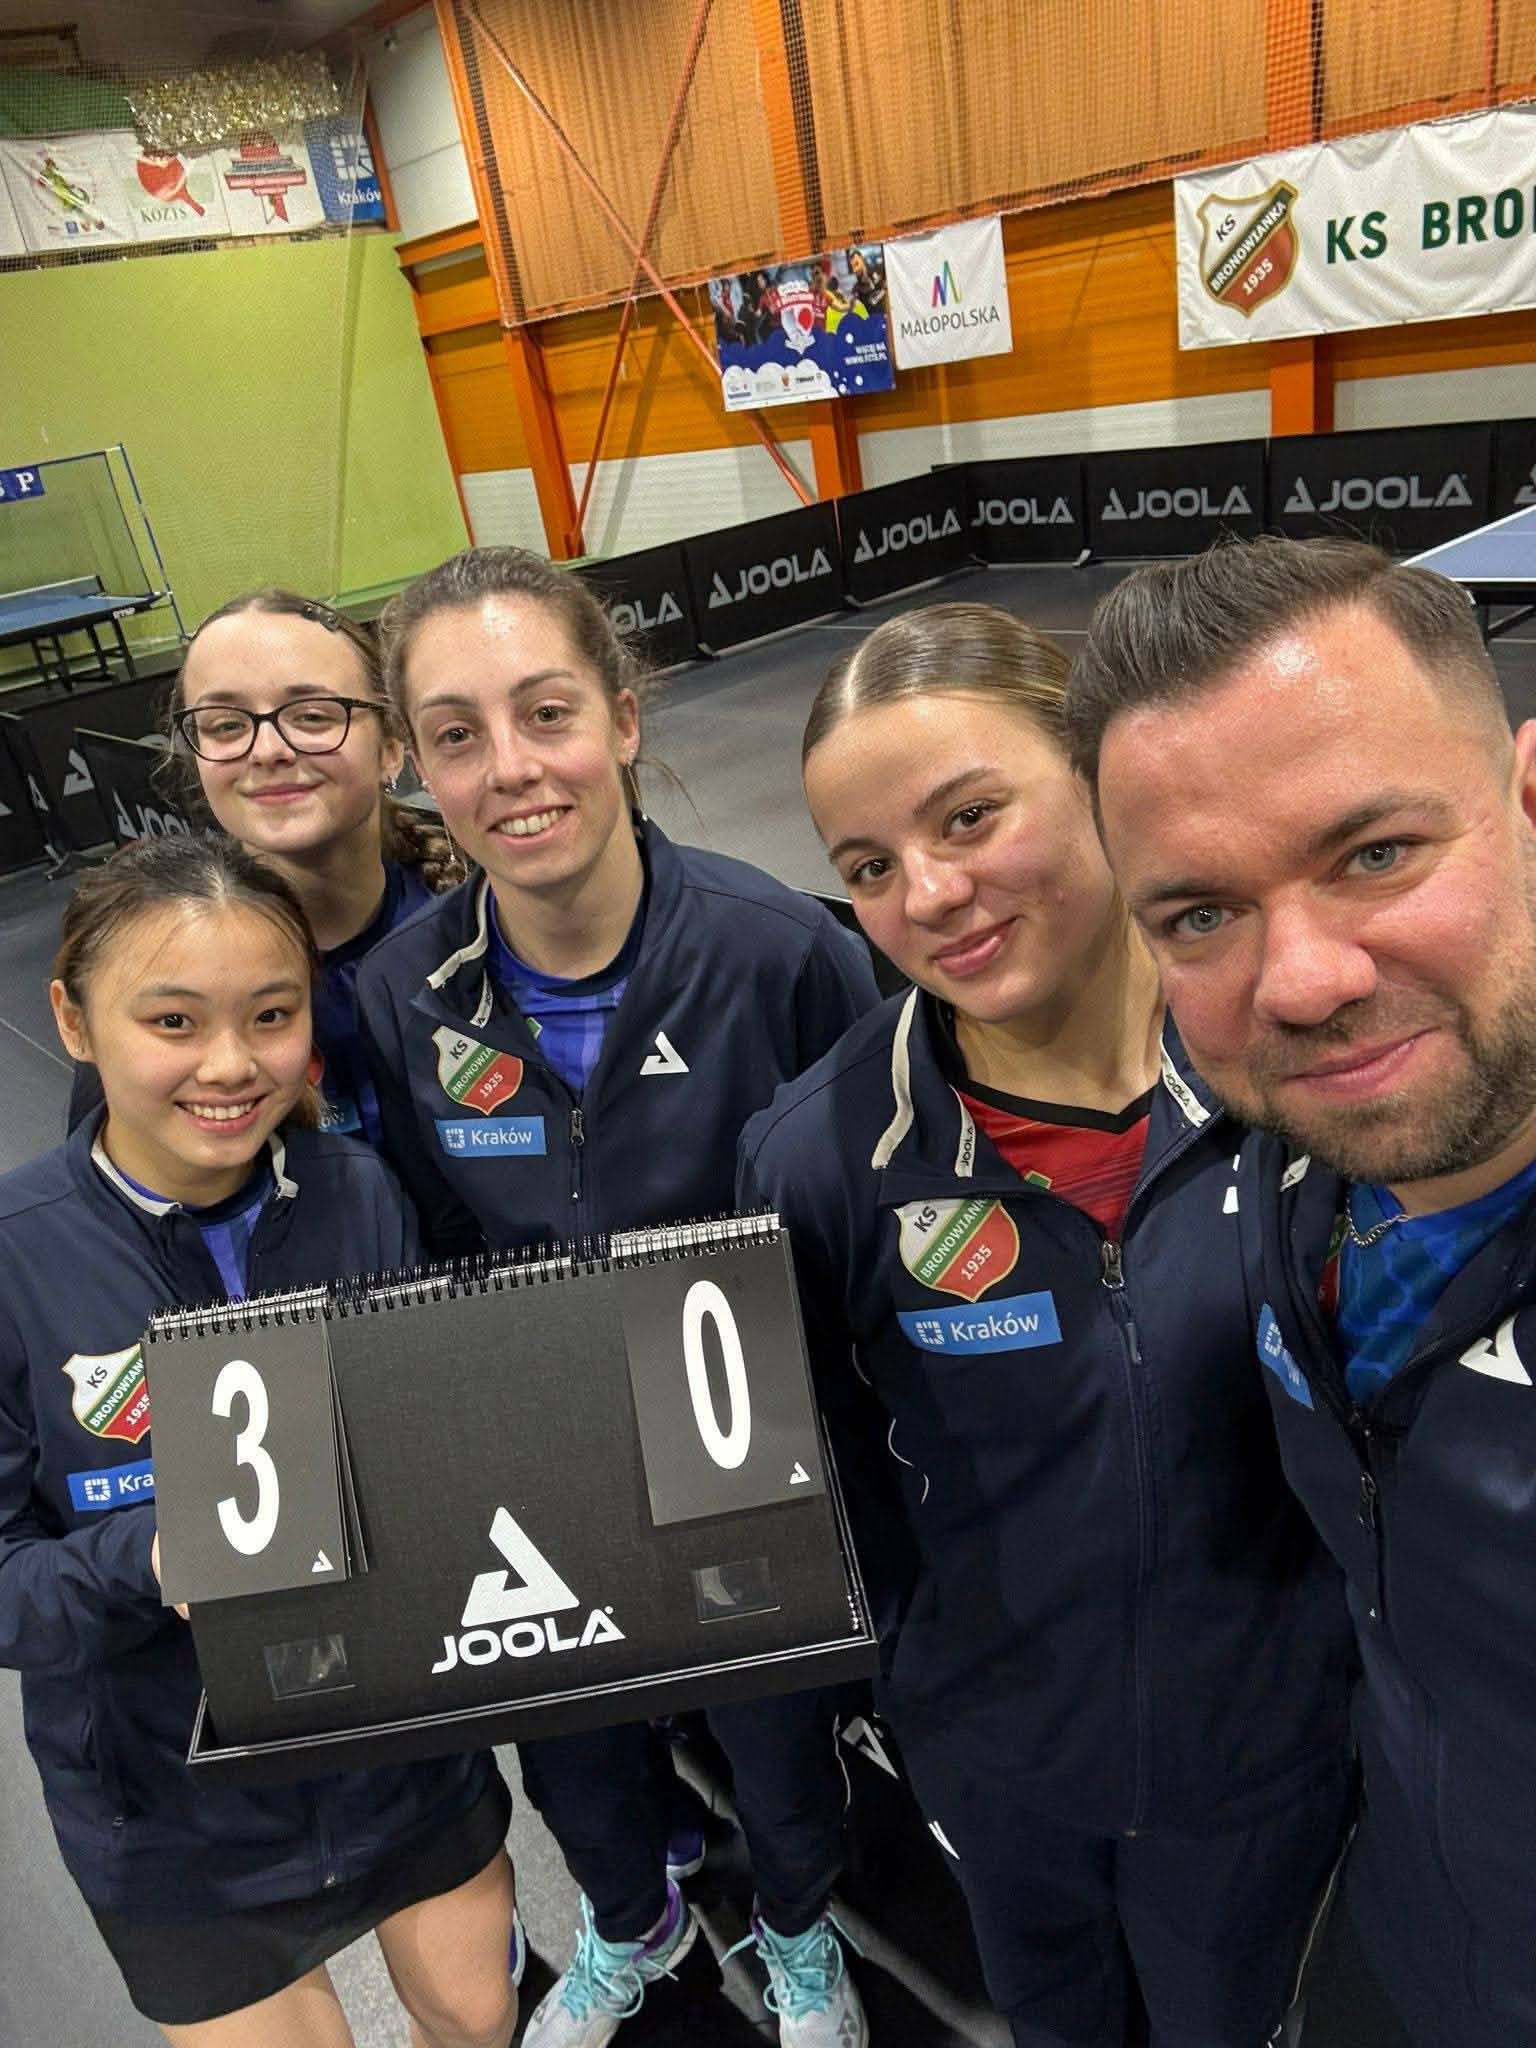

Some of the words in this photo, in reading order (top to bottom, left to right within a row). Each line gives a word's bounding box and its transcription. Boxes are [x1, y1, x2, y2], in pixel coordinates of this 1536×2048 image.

[1216, 214, 1236, 242] KS
[1327, 211, 1388, 263] KS
[1422, 187, 1536, 250] BRO
[1210, 201, 1287, 292] BRONOWIANKA
[1243, 258, 1273, 296] 1935
[901, 305, 1000, 338] MAŁOPOLSKA
[1128, 485, 1252, 520] JOOLA
[1319, 473, 1473, 512] JOOLA
[970, 497, 1075, 527] JOOLA
[876, 508, 962, 556] JOOLA
[734, 548, 832, 600] JOOLA
[450, 1039, 468, 1060] KS
[480, 1071, 504, 1098] 1935
[1165, 1072, 1190, 1106] JOOLA
[471, 1127, 532, 1146] Kraków
[960, 1126, 974, 1167] JOOLA
[914, 1206, 937, 1232] KS
[961, 1244, 992, 1281] 1935
[950, 1311, 1039, 1342] Kraków
[86, 1365, 108, 1389] KS
[683, 1280, 751, 1469] 0
[211, 1359, 280, 1556] 3
[118, 1473, 155, 1494] Kra
[431, 1606, 627, 1675] JOOLA
